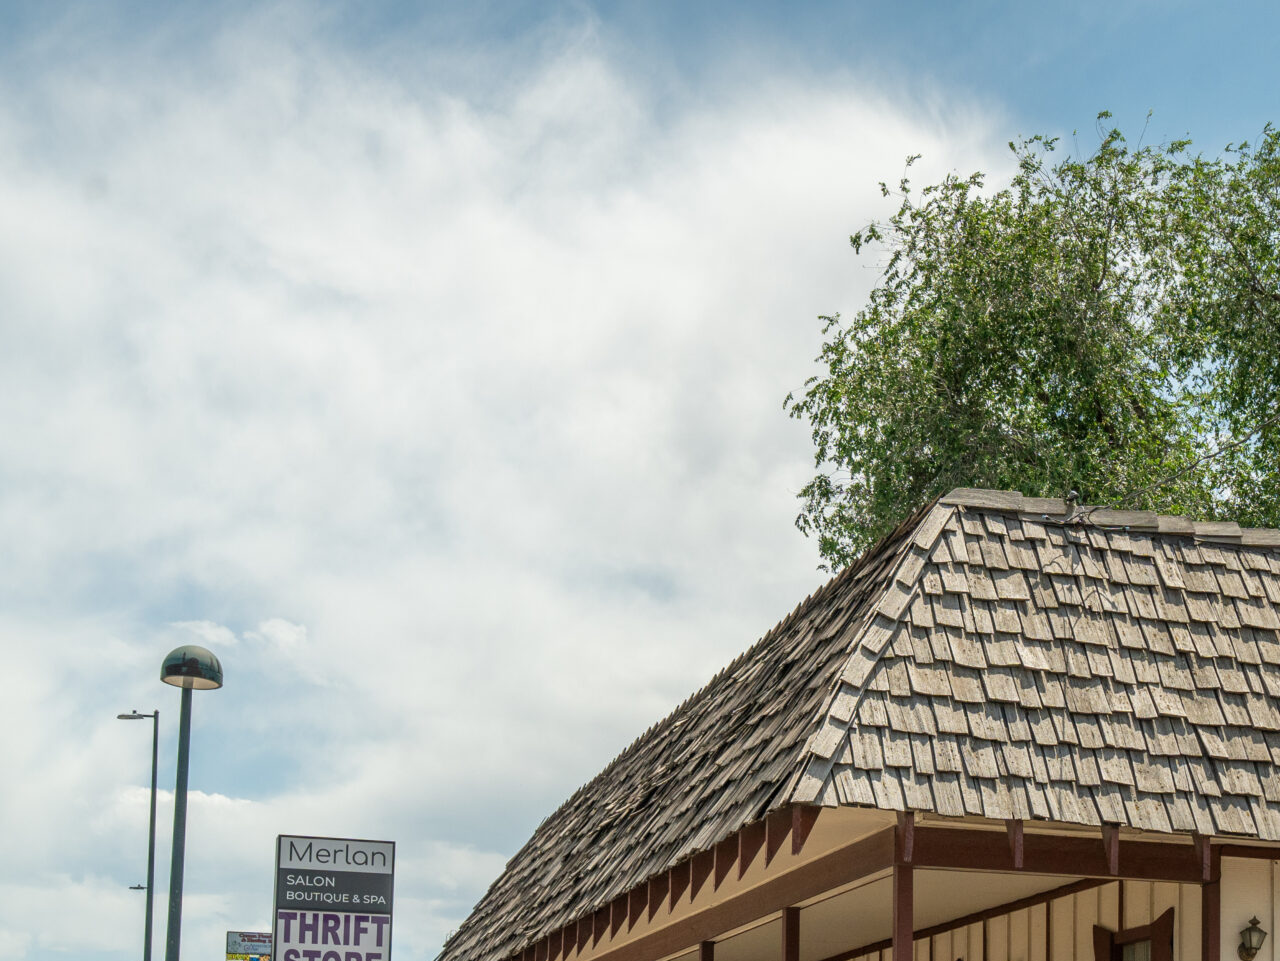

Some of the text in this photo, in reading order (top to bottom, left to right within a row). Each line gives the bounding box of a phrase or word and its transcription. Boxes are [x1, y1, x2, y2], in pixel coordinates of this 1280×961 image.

[289, 840, 387, 867] Merlan
[286, 874, 336, 888] SALON
[286, 890, 387, 905] BOUTIQUE & SPA
[278, 911, 390, 948] THRIFT
